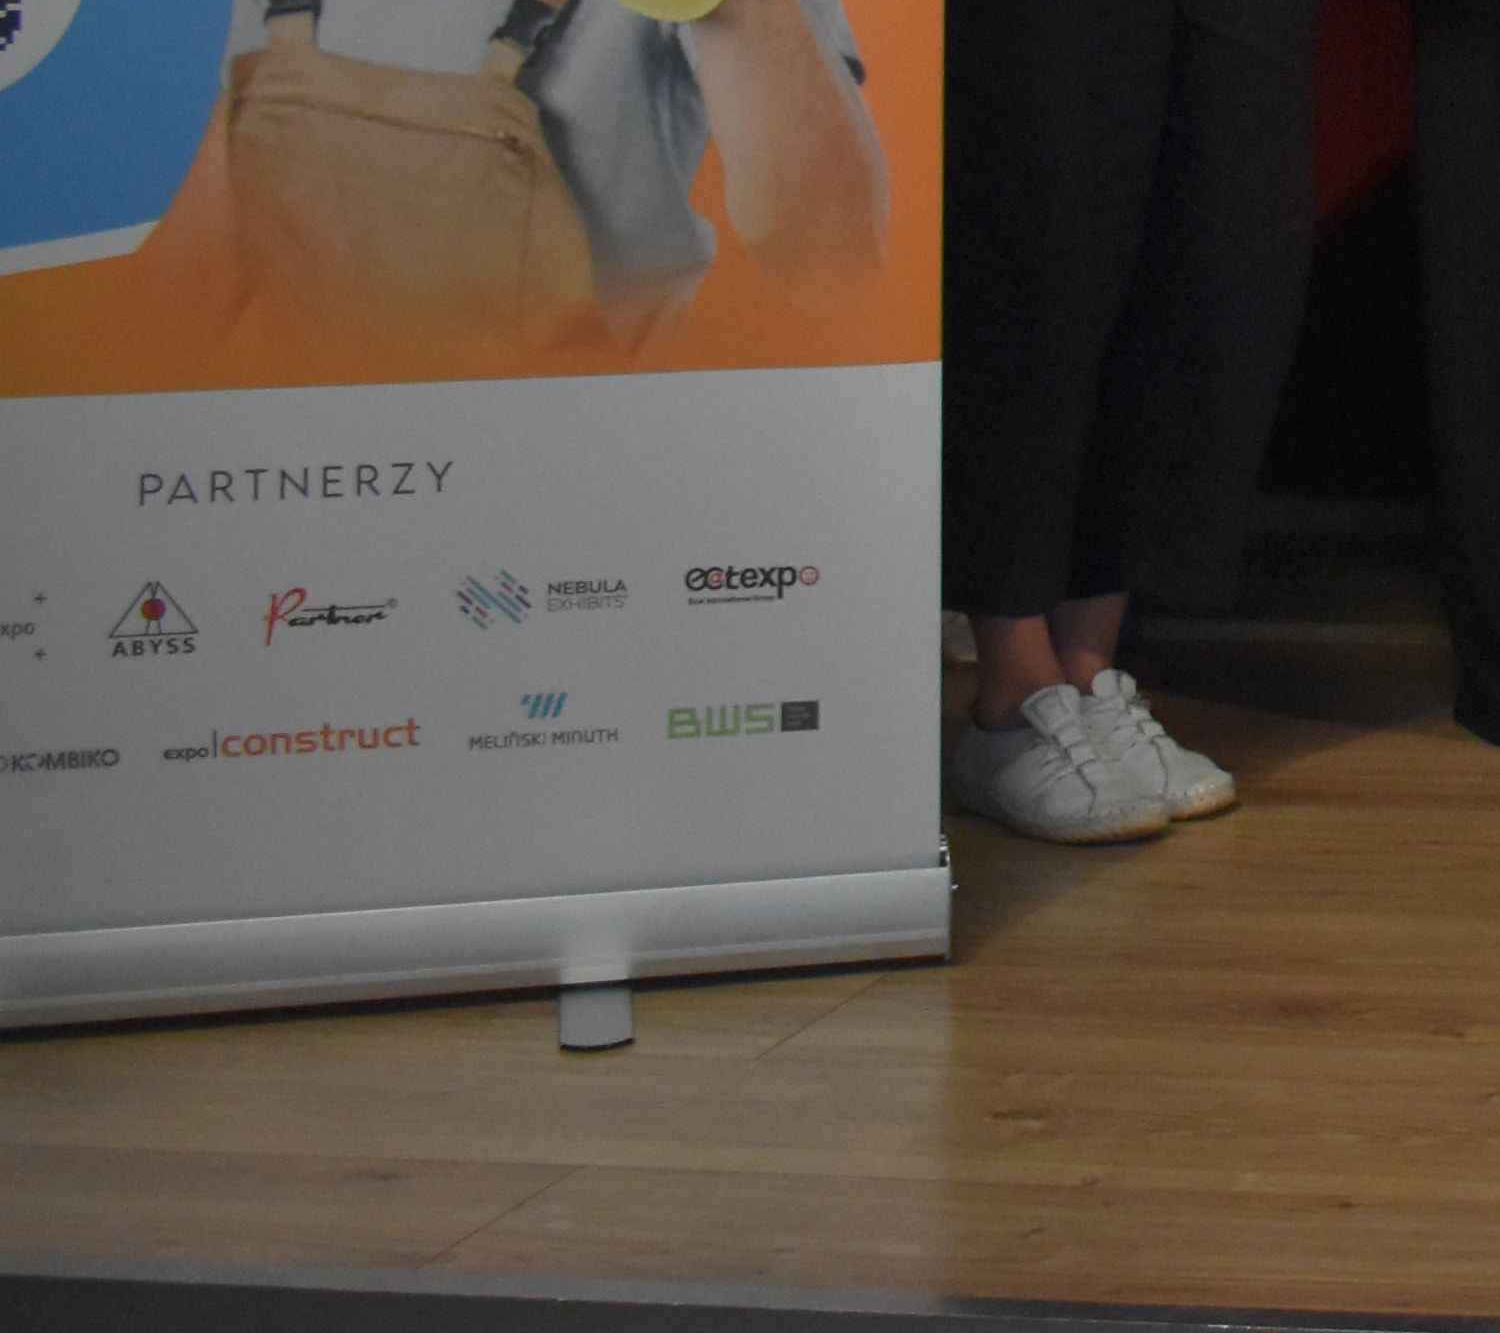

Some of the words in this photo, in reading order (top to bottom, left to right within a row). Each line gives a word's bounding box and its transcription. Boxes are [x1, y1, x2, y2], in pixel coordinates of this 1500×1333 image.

[138, 460, 456, 507] PARTNERZY
[547, 579, 628, 595] NEBULA
[546, 594, 627, 612] EXHIBITS
[111, 636, 197, 658] ABYSS
[667, 703, 776, 740] BWS
[221, 717, 421, 759] construct
